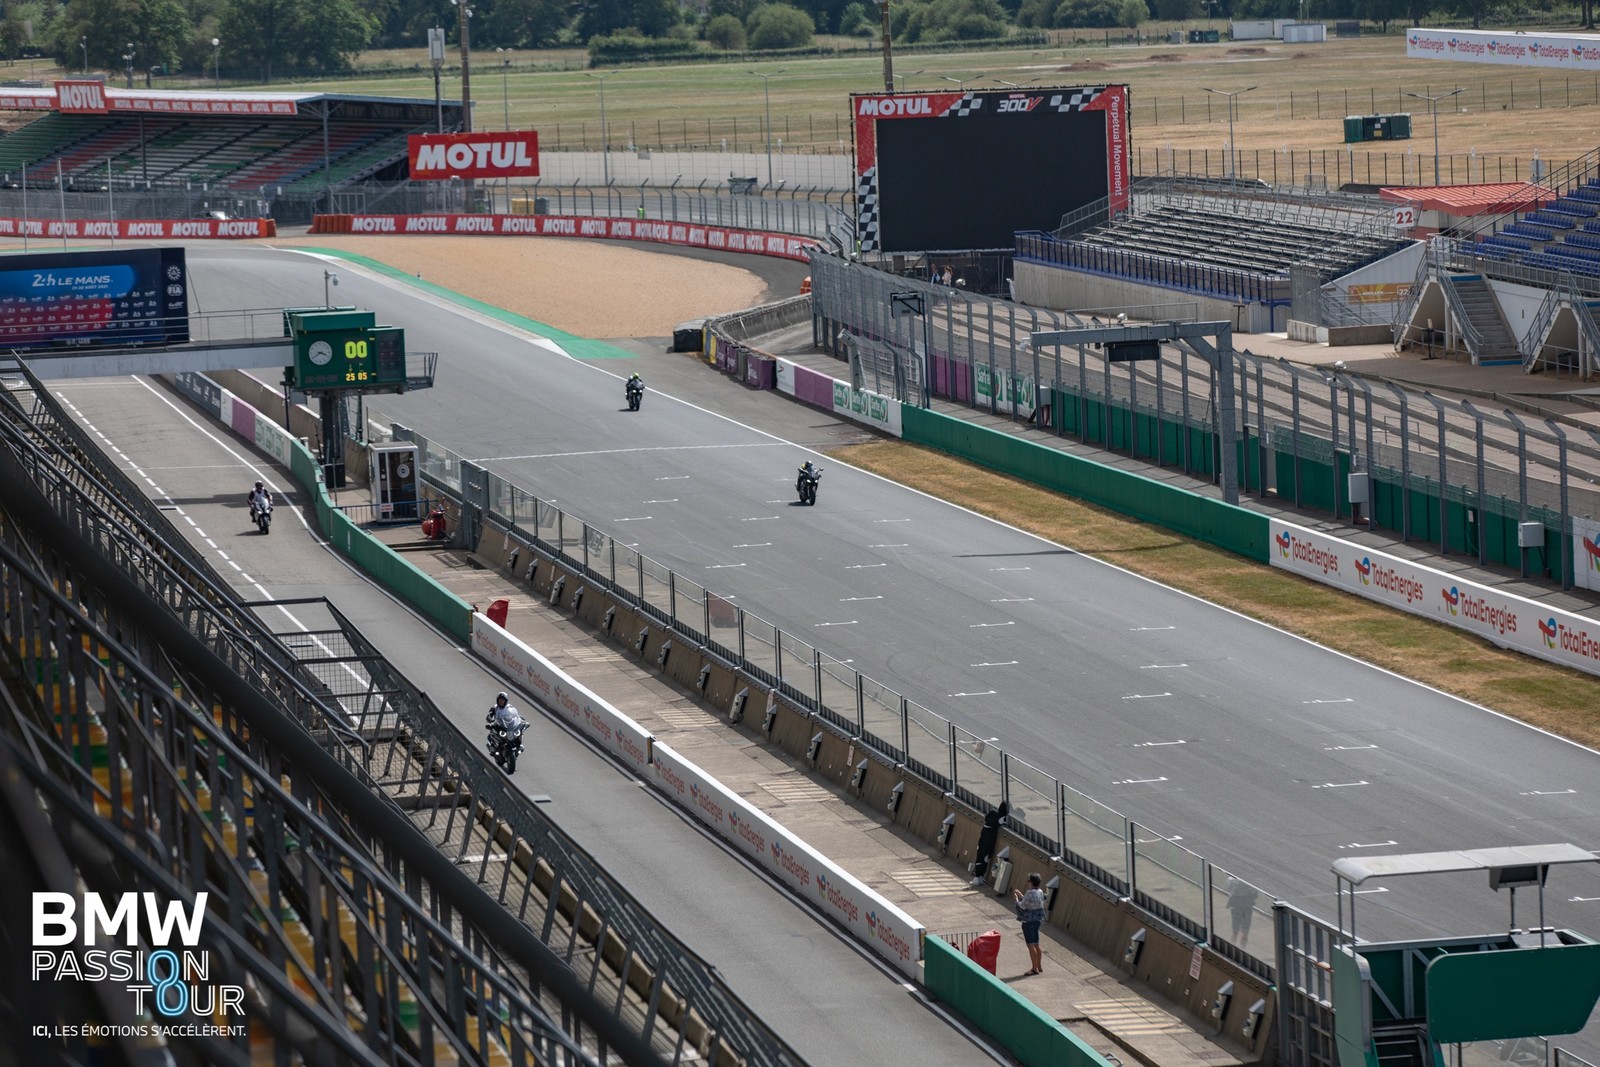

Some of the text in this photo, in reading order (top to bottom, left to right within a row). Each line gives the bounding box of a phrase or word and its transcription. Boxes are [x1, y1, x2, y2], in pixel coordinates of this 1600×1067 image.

[1418, 38, 1444, 53] TotalEnergies
[1457, 40, 1484, 56] TotalEnergies
[1496, 42, 1525, 58] TotalEnergies
[1539, 44, 1568, 61] TotalEnergies
[60, 85, 104, 109] MOTUL
[860, 97, 932, 115] MOTUL
[997, 96, 1044, 112] 300V
[416, 142, 532, 170] MOTUL
[1111, 96, 1122, 196] Perpetual Movement
[1396, 211, 1413, 224] 22
[18, 221, 43, 234] MOTUL
[48, 222, 78, 236] MOTUL
[84, 222, 118, 236] MOTUL
[128, 222, 164, 236] MOTUL
[171, 222, 211, 236] MOTUL
[218, 222, 258, 236] MOTUL
[352, 218, 396, 232] MOTUL
[406, 217, 447, 231] MOTUL
[455, 218, 494, 232] MOTUL
[502, 218, 536, 232] MOTUL
[542, 219, 575, 234] MOTUL
[581, 220, 606, 235] MOTUL
[611, 222, 632, 236] MOTUL
[652, 224, 669, 240] MOTUL
[58, 278, 74, 286] LE
[75, 275, 110, 284] MANS
[345, 341, 367, 359] 00
[346, 372, 368, 382] 25 05
[1291, 536, 1338, 574] TotalEnergies
[1372, 562, 1423, 604] TotalEnergies
[1460, 592, 1517, 635] TotalEnergies
[780, 848, 810, 886] TotalEnergies
[826, 882, 858, 922] TotalEnergies
[876, 918, 910, 961] TotalEnergies
